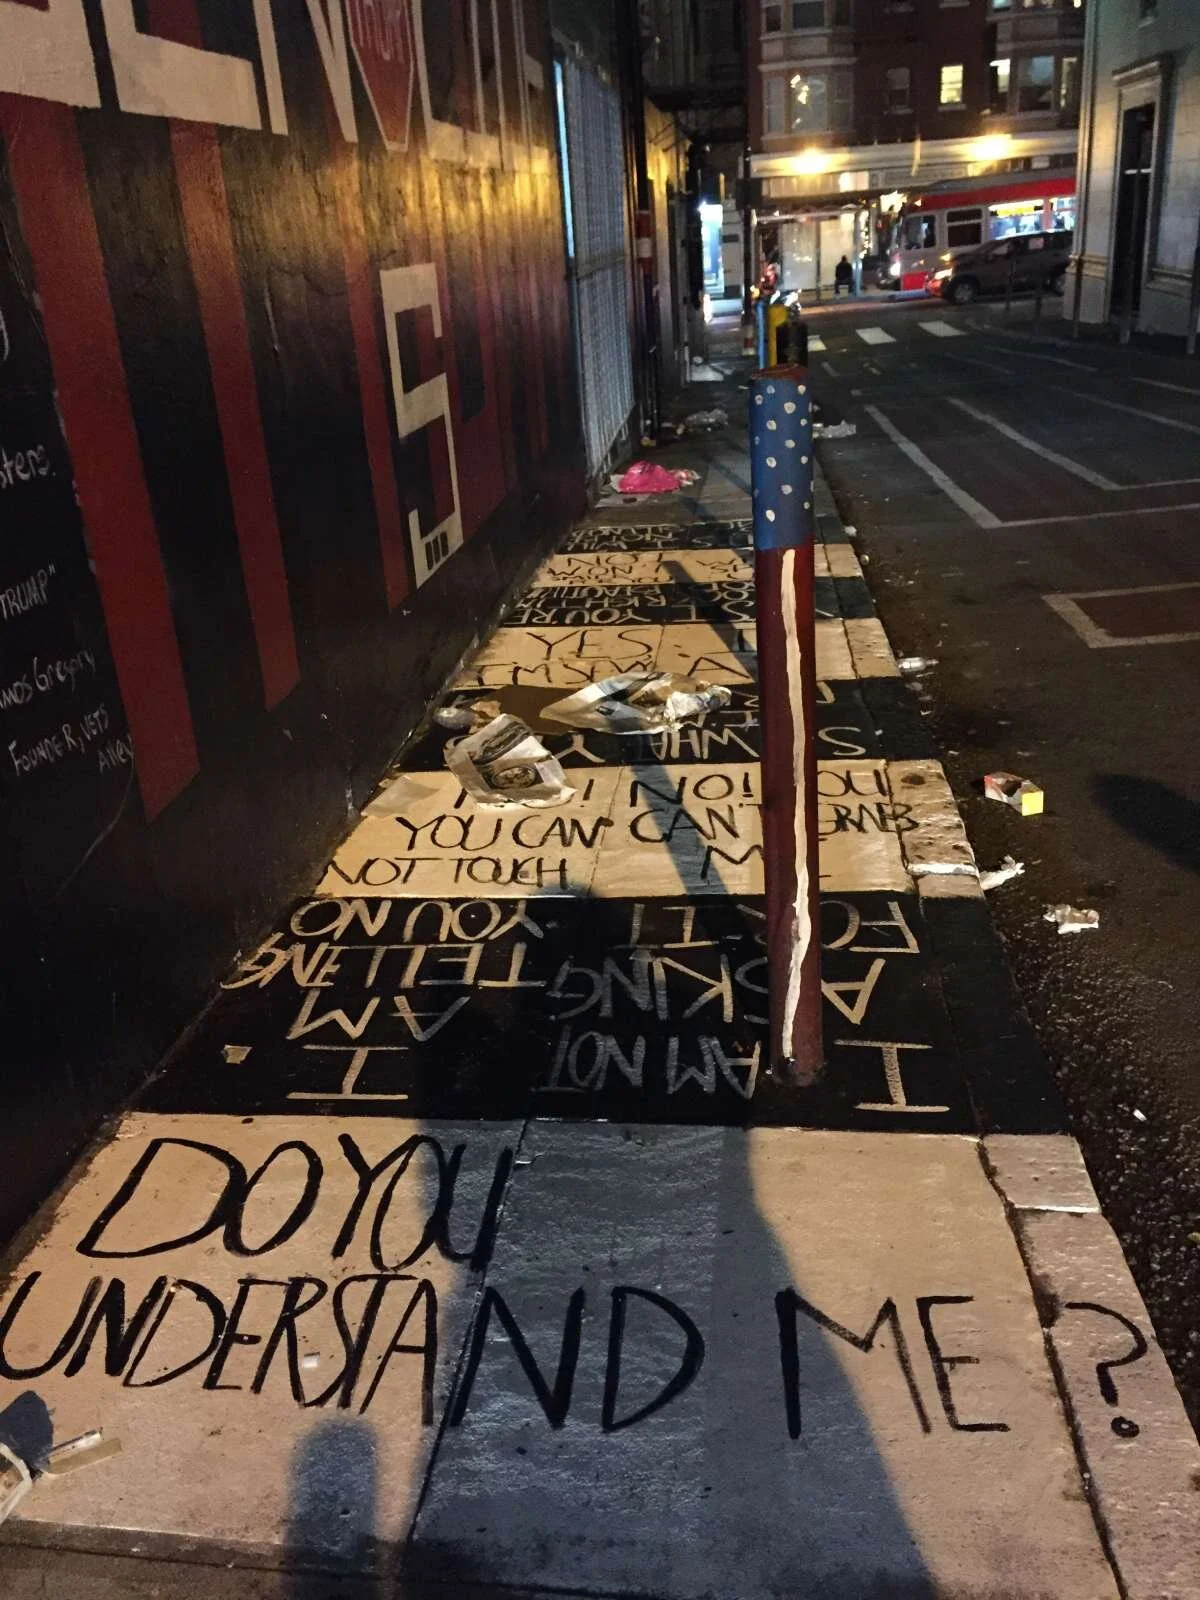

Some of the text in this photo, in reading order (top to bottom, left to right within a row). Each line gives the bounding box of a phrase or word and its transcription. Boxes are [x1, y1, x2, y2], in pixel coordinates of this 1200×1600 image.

[526, 629, 653, 661] YES
[629, 771, 755, 808] NO!
[816, 769, 892, 798] OU
[395, 813, 615, 851] YOU CAN
[316, 856, 568, 889] NOT TOUCH
[290, 898, 545, 943] YOU NO
[285, 988, 472, 1043] AM
[286, 1043, 410, 1100] I
[531, 1026, 951, 1113] I AM NOT
[76, 1133, 515, 1273] DO YOU
[0, 1269, 705, 1434] UNDERSTAND
